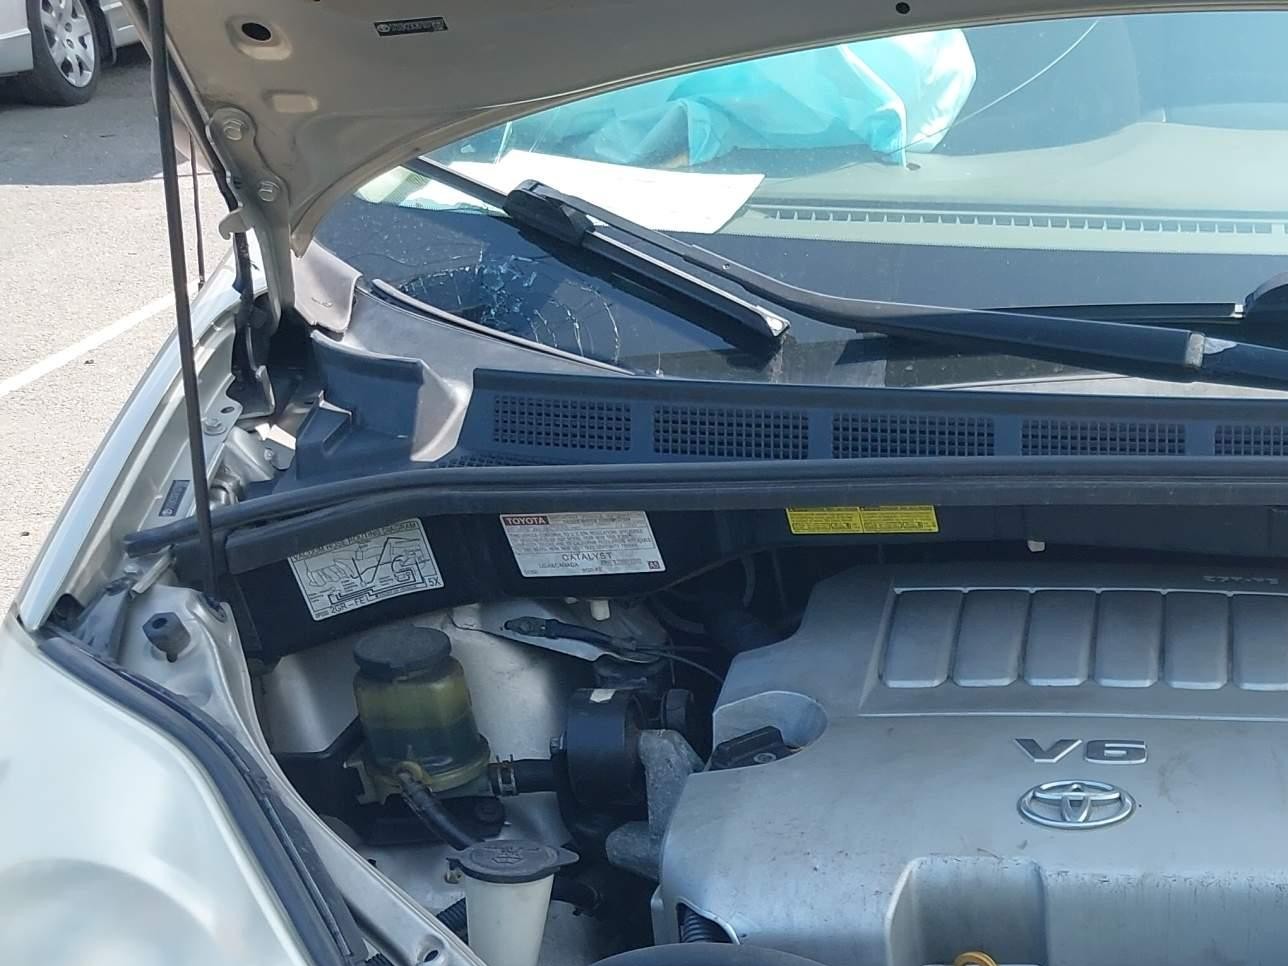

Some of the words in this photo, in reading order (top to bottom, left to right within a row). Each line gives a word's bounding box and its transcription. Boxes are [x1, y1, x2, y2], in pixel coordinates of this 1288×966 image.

[504, 516, 546, 526] TOYOTA
[561, 551, 613, 561] CATALYST
[427, 577, 442, 587] 5X
[329, 595, 366, 614] 2GR-FE
[1013, 738, 1149, 765] V6
